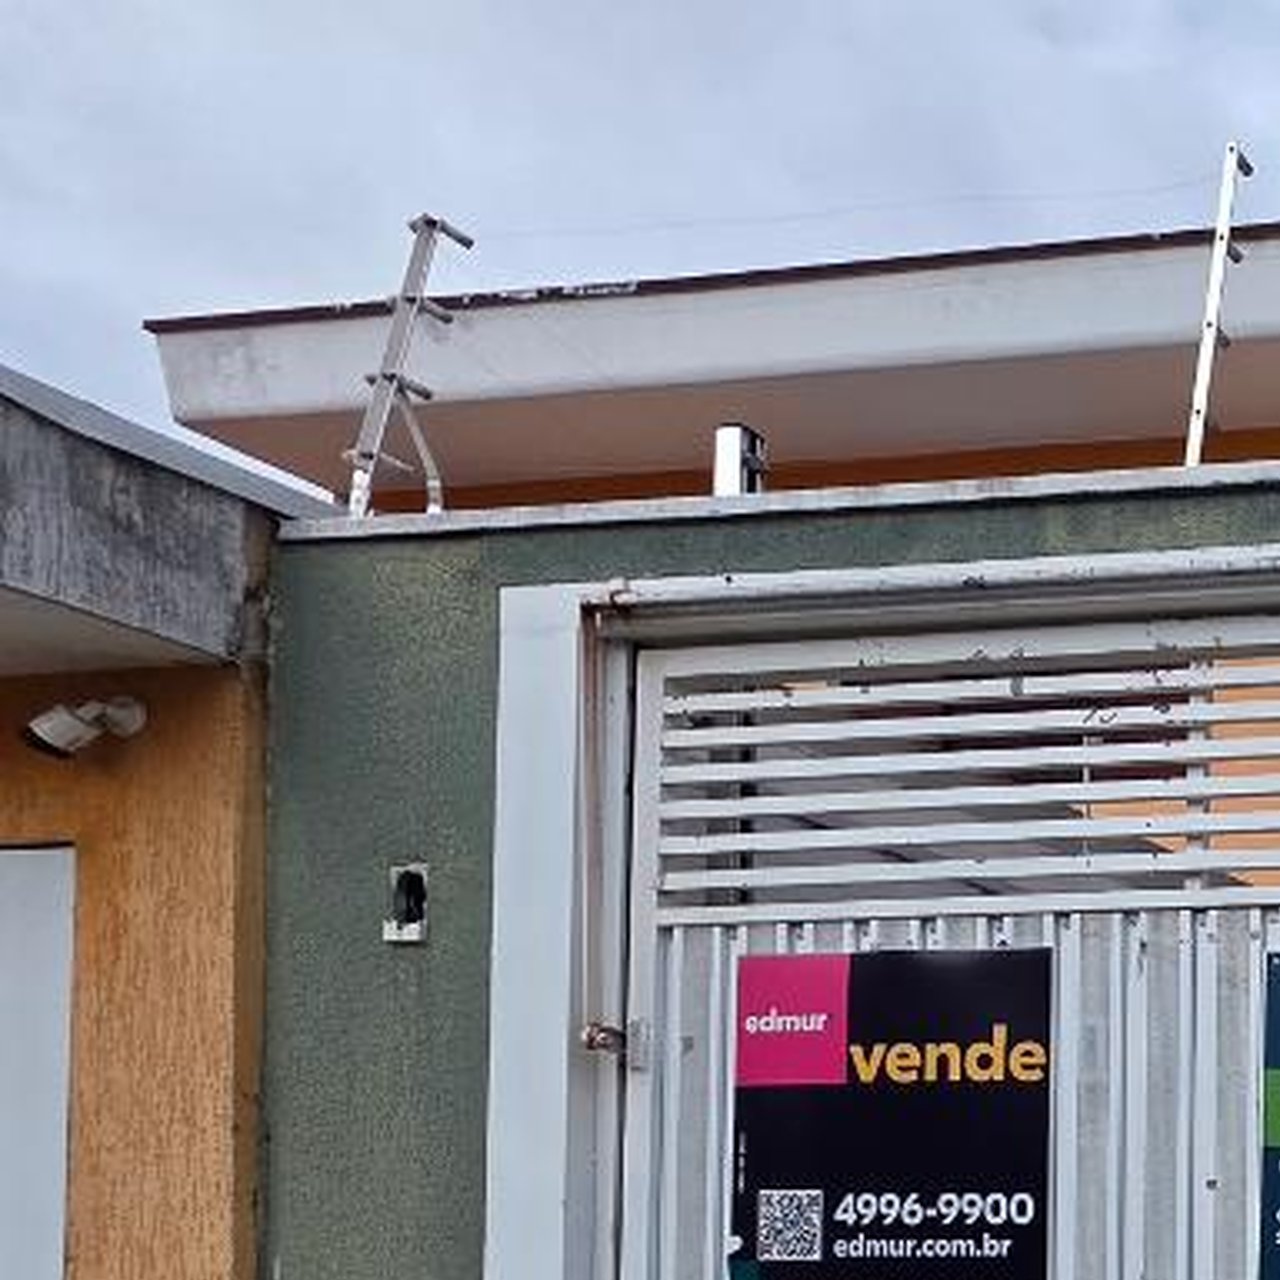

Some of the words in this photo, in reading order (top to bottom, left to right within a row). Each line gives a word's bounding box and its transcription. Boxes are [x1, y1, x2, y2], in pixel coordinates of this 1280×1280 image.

[745, 1007, 827, 1034] edmur
[850, 1023, 1048, 1084] vende
[833, 1193, 1035, 1226] 4996-9900
[833, 1233, 1013, 1259] edmur.com.br
